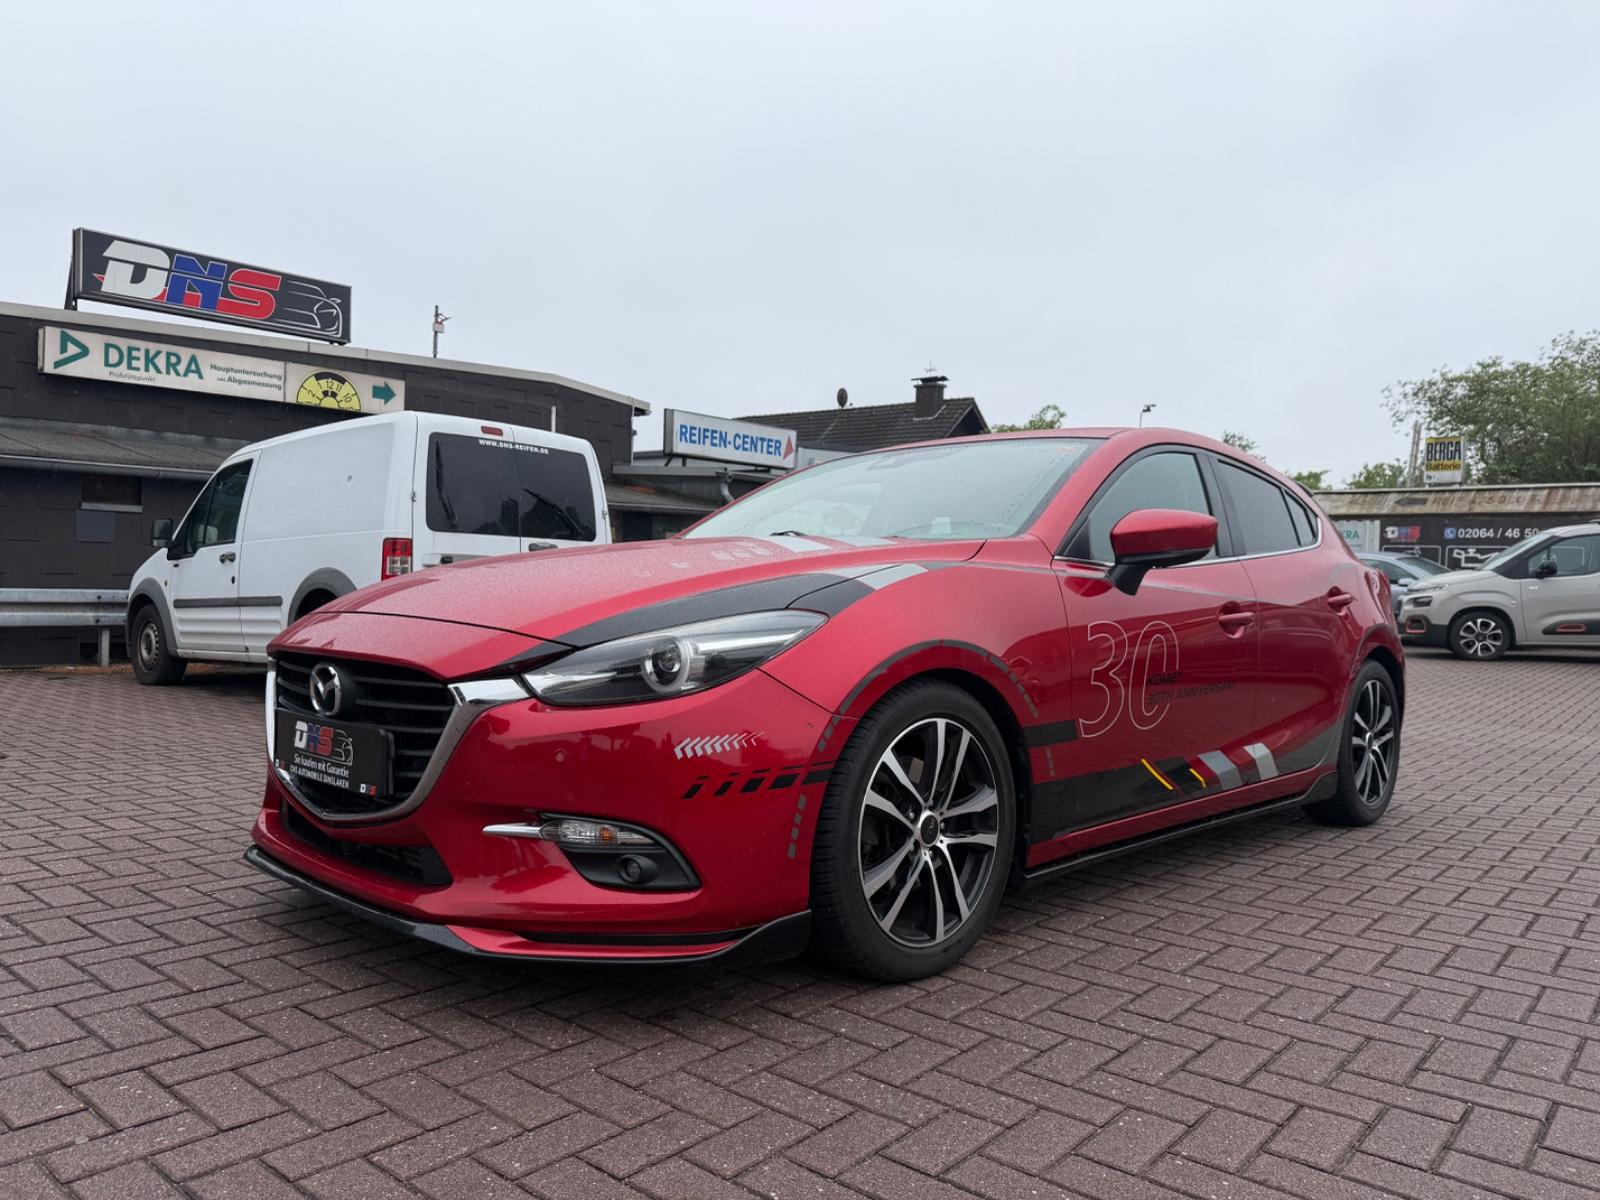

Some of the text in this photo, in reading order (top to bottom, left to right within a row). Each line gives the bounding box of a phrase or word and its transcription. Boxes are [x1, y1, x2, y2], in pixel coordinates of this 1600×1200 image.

[101, 240, 282, 320] DNS
[103, 342, 205, 380] DEKRA
[210, 363, 282, 381] Hauptuntersuchung
[227, 375, 282, 392] Abgasmessung
[325, 380, 335, 390] 12
[343, 392, 353, 403] 10
[1426, 441, 1462, 461] BERGA
[1457, 528, 1495, 539] 02064
[1497, 528, 1503, 540] /
[1504, 528, 1520, 539] 46
[326, 762, 349, 778] Garantie
[323, 774, 350, 788] DINSLAKEN
